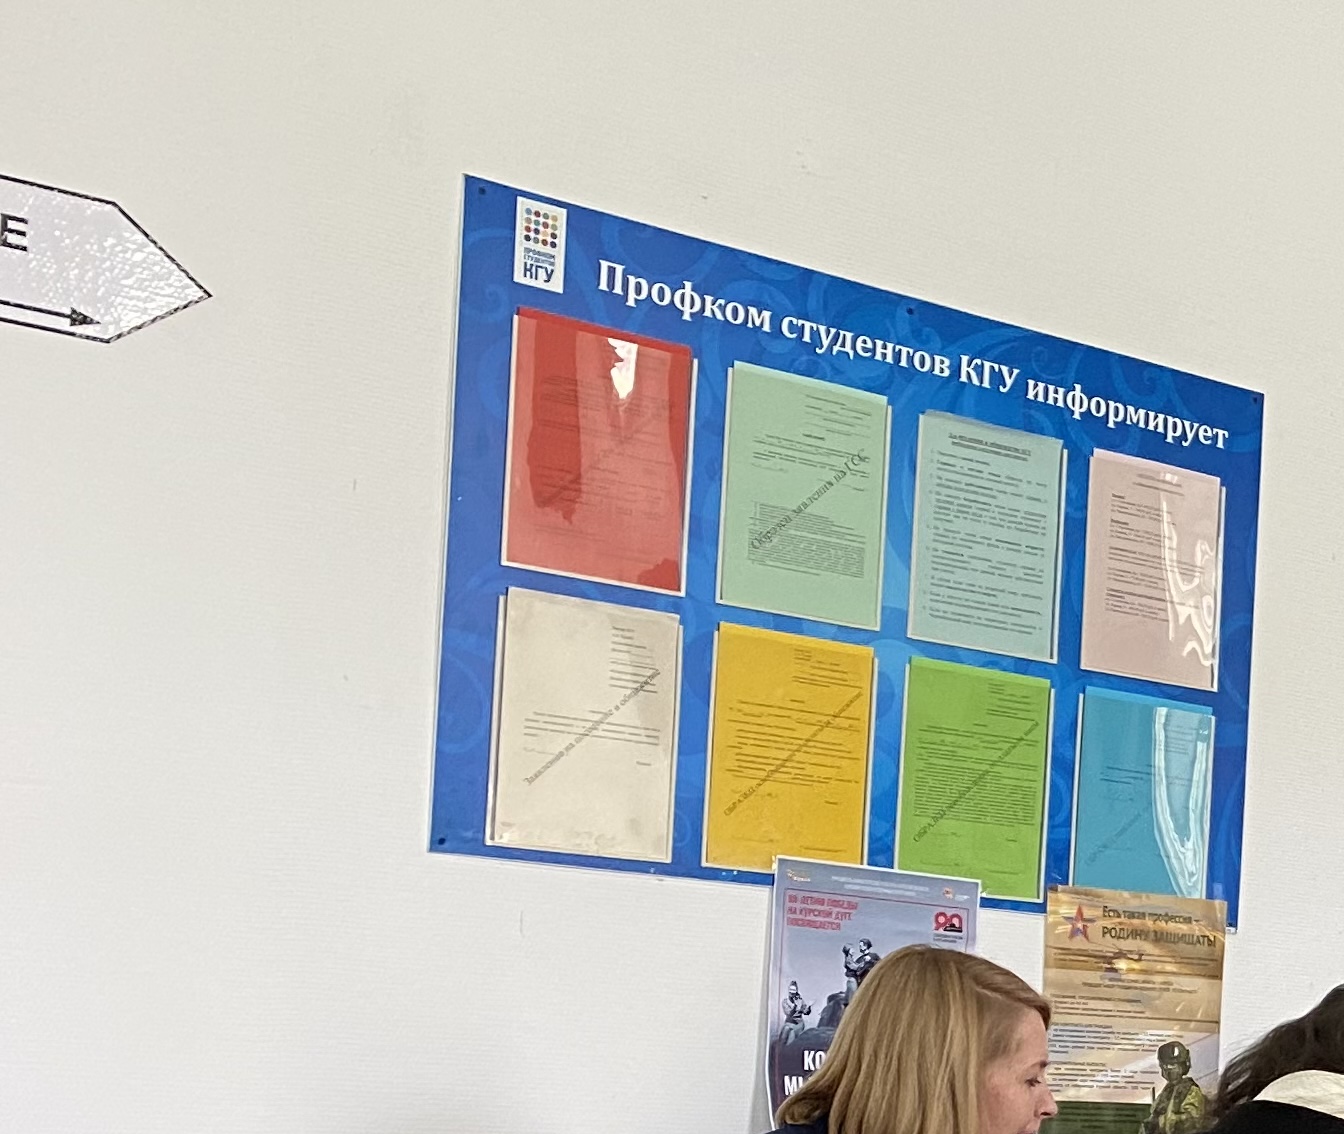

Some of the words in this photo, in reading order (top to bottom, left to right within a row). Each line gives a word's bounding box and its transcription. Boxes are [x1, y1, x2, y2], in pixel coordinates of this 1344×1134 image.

[523, 261, 554, 283] КГУ
[598, 259, 772, 332] Профком
[780, 315, 952, 378] студентов
[959, 354, 1020, 393] КГУ
[1026, 379, 1229, 449] информирует
[1102, 925, 1149, 941] РОДИНУ
